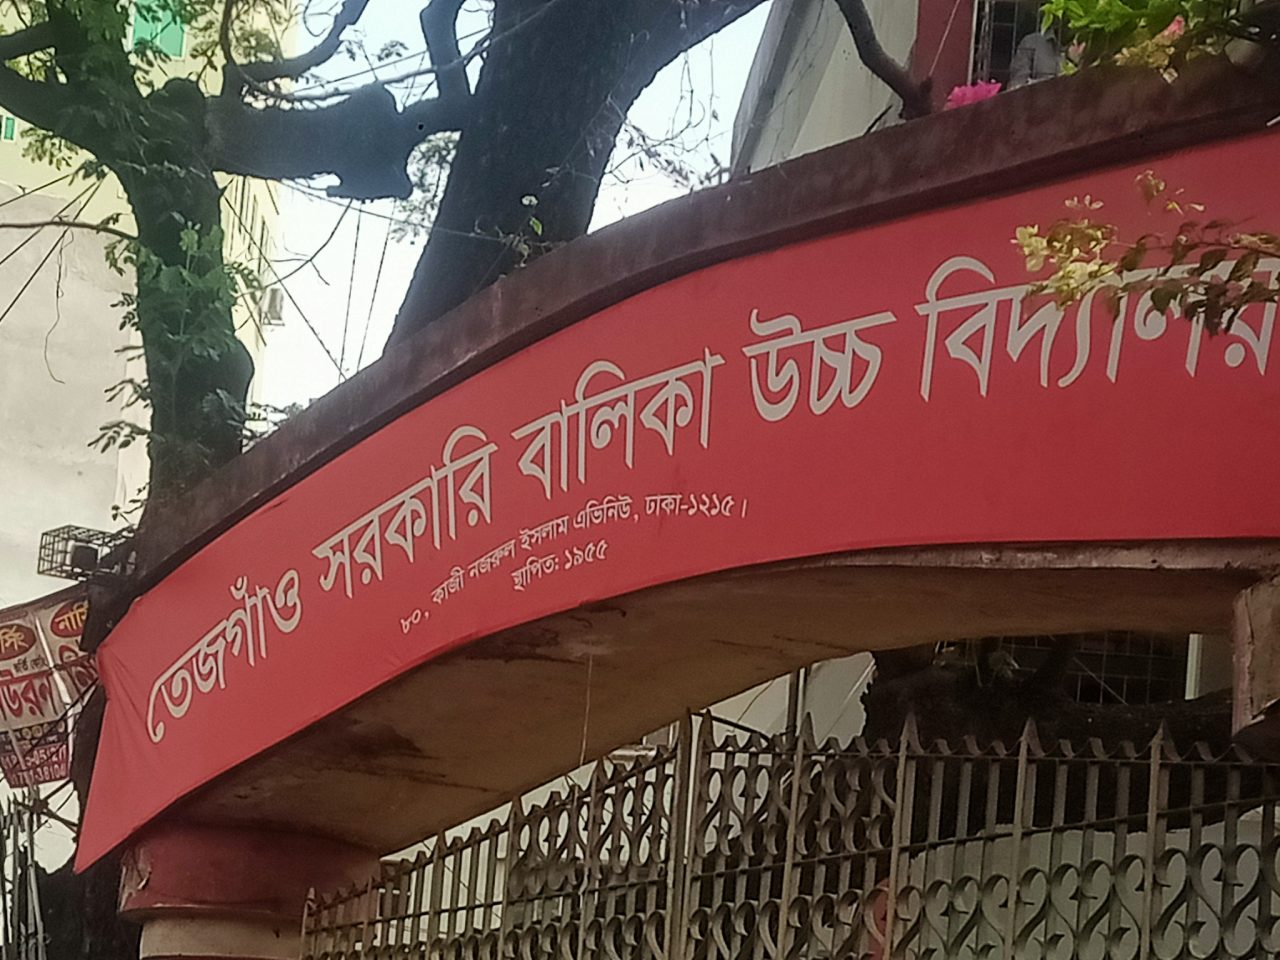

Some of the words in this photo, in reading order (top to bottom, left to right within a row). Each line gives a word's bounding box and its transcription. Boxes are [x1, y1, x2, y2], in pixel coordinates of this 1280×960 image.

[147, 569, 303, 743] তেজগাঁও
[312, 425, 498, 598] সরকারি
[511, 346, 726, 500] বালিকা
[741, 308, 898, 422] উচ্চ
[431, 566, 465, 605] কাজী
[468, 538, 517, 579] নজরুল
[519, 514, 569, 550] ইসলাম
[573, 496, 639, 532] এভিনিউ,
[563, 537, 609, 571] ১৯৫৫
